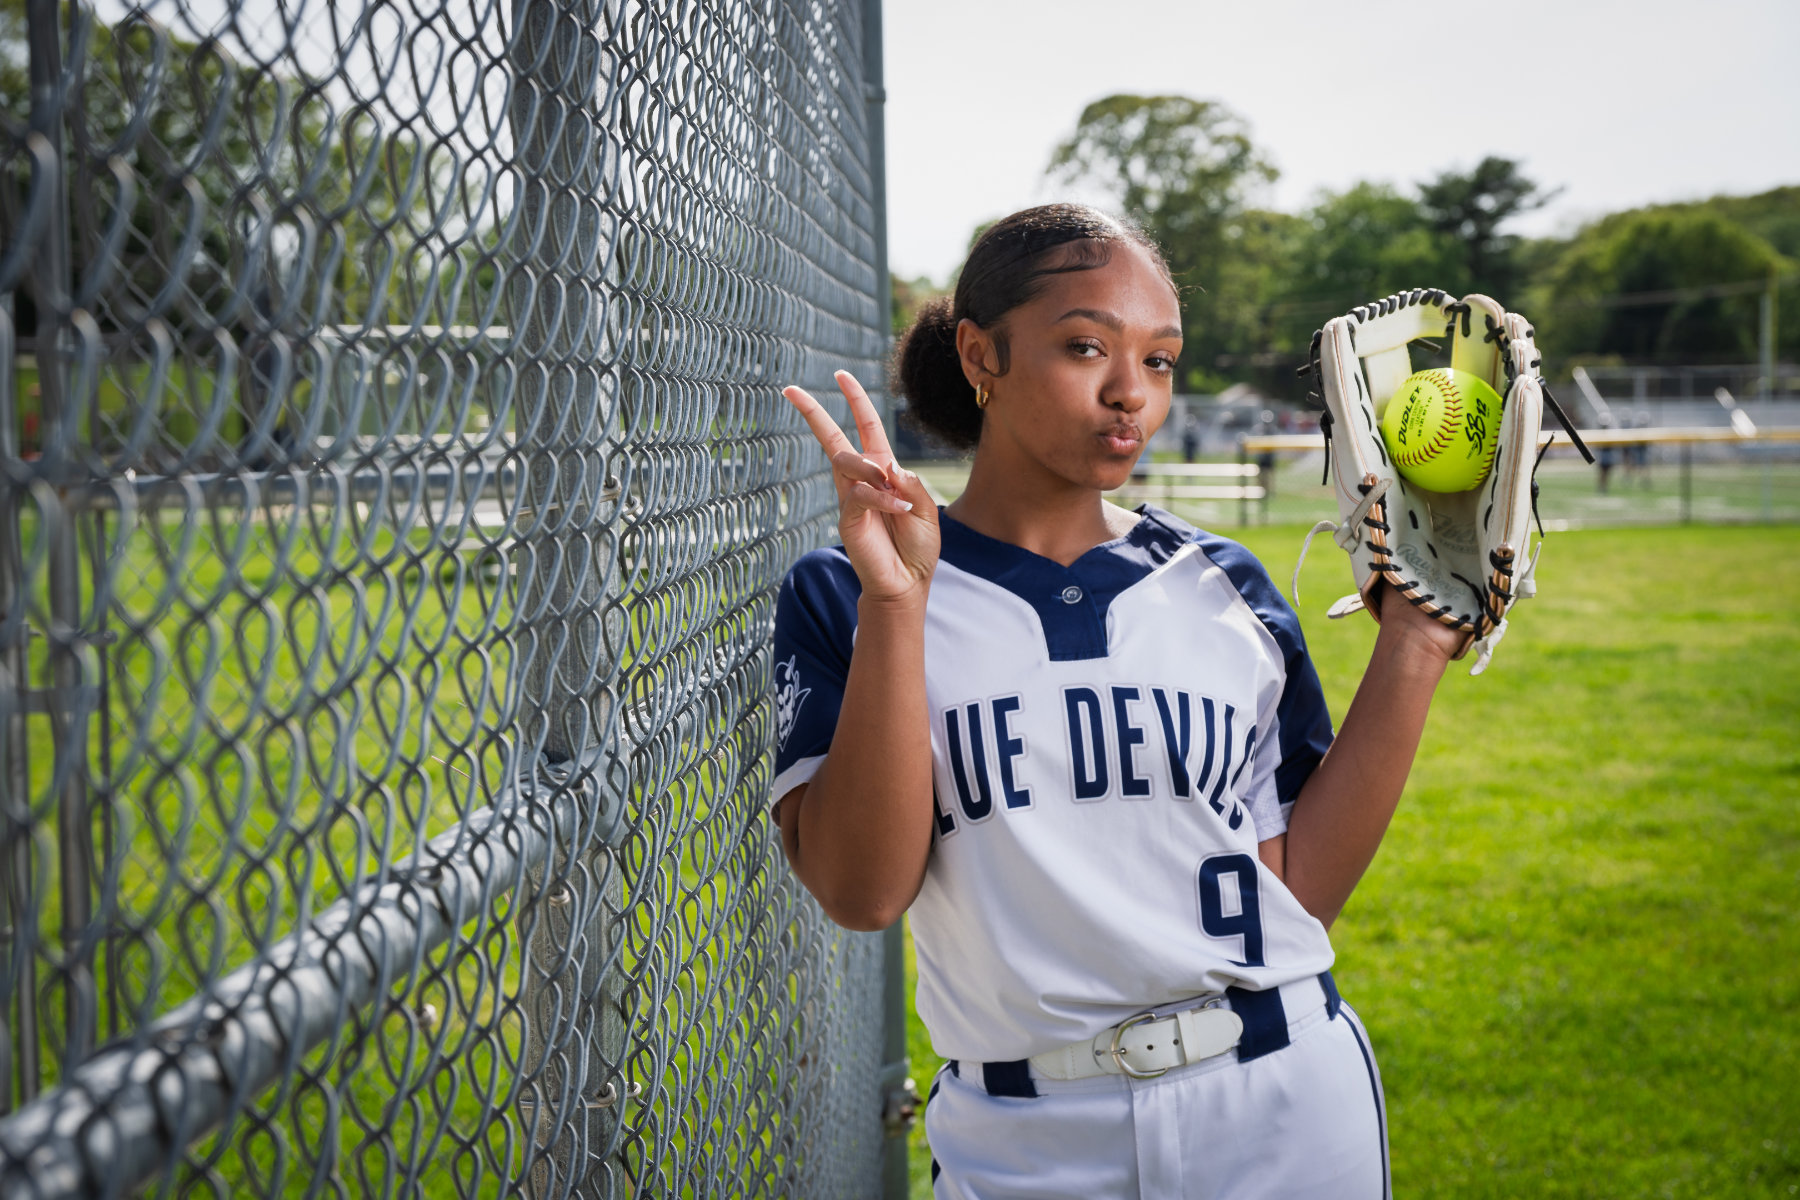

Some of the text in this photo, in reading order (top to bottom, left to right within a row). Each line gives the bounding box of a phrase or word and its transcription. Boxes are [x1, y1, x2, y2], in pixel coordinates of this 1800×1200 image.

[1398, 386, 1420, 446] DUDLEY
[932, 694, 1032, 838] LUE
[1197, 852, 1266, 968] 9
